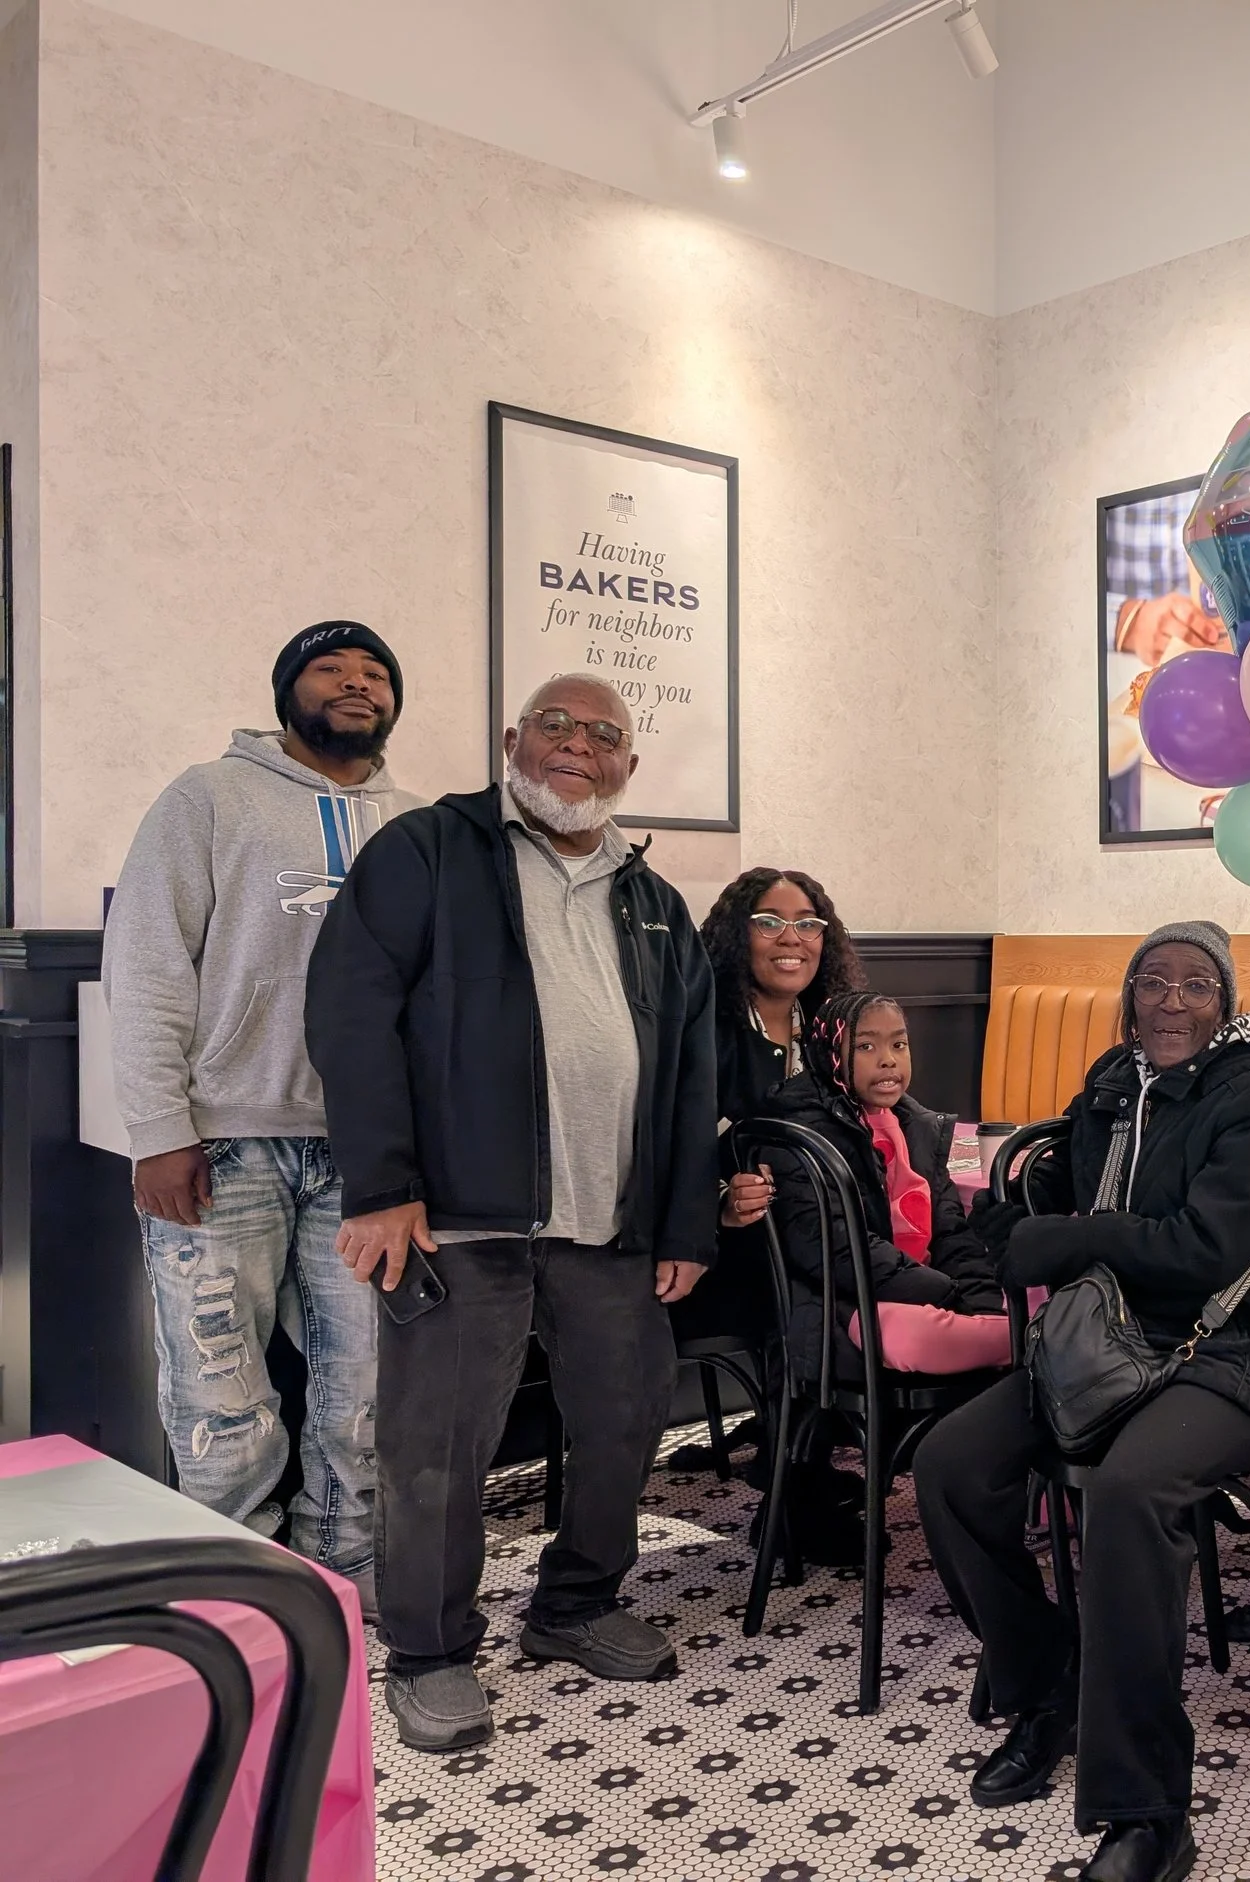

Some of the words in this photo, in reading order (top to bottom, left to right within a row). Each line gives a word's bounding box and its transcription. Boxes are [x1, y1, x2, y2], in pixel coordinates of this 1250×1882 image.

[576, 531, 666, 577] Having
[540, 561, 700, 611] BAKERS
[541, 598, 580, 633] for
[588, 610, 694, 643] neighbors
[586, 641, 605, 665] is
[613, 646, 658, 672] nice
[649, 684, 692, 709] you
[637, 709, 660, 734] it.
